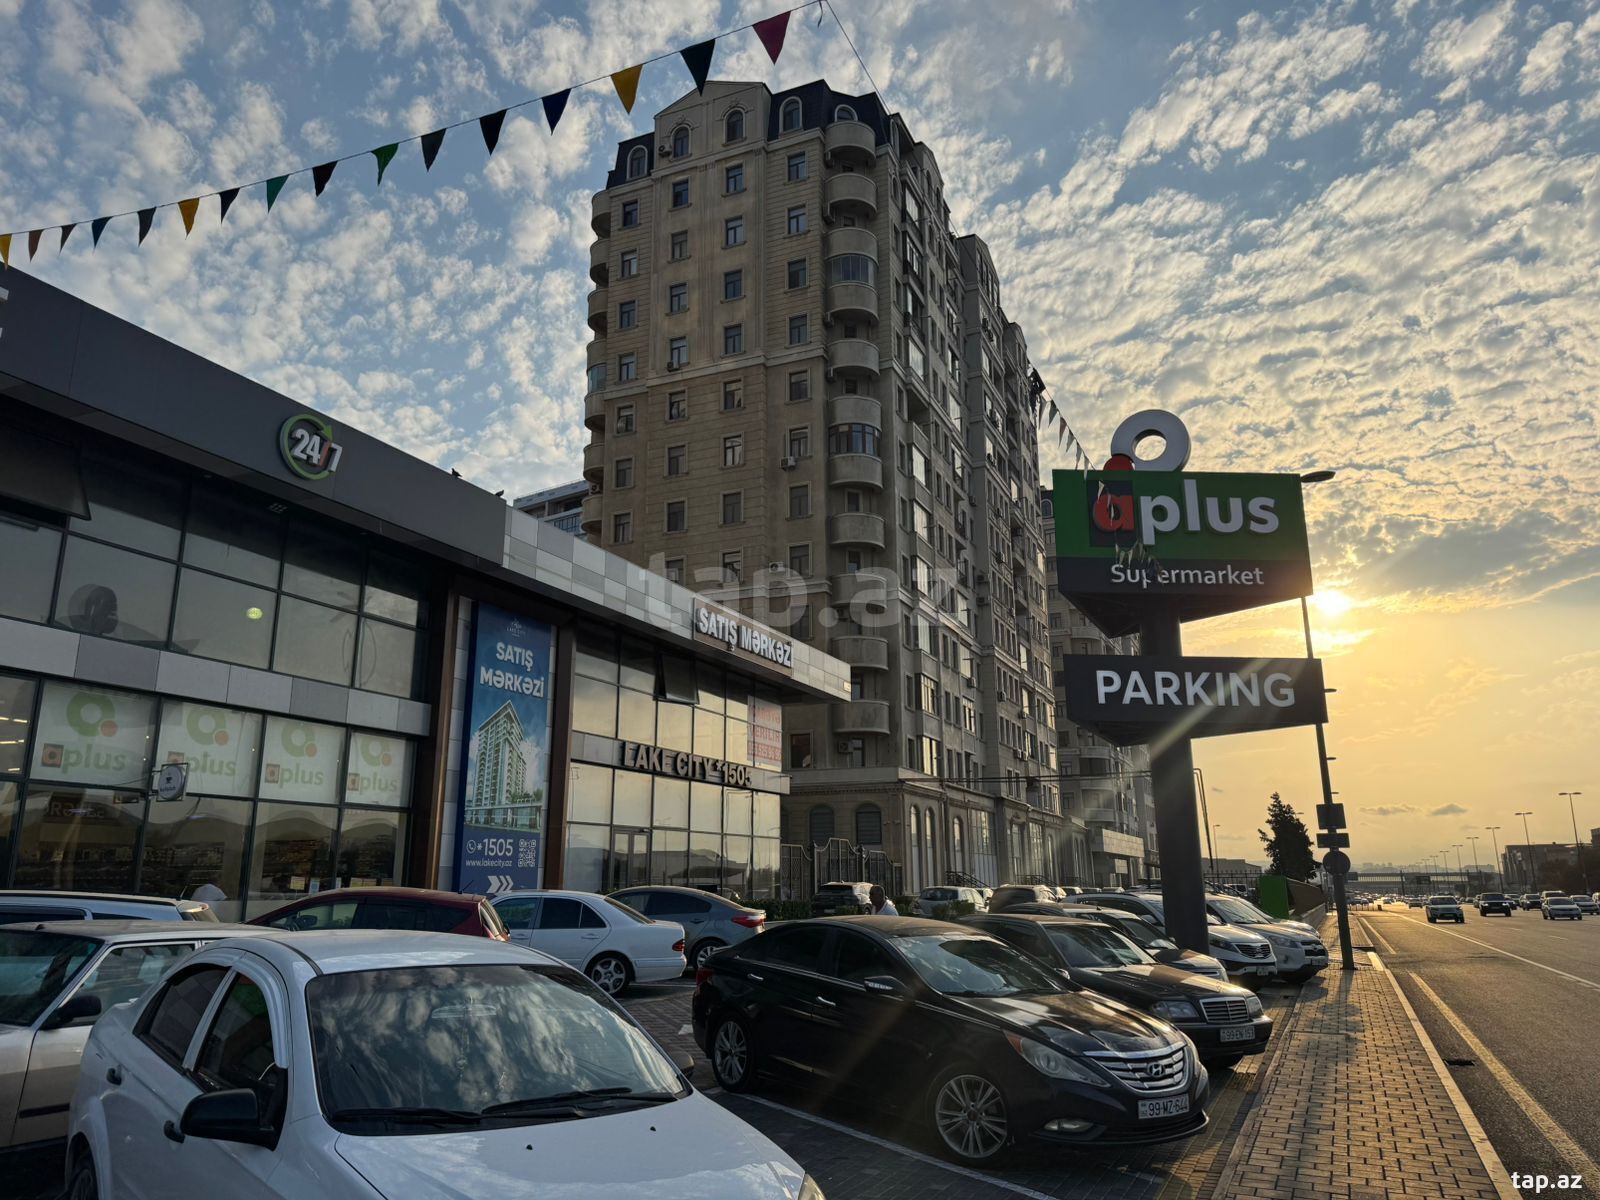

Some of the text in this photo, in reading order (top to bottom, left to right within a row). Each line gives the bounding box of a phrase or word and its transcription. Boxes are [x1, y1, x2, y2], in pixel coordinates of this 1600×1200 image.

[291, 428, 343, 472] 24/7
[1092, 479, 1280, 546] aplus
[699, 607, 738, 652] SATIŞ
[496, 641, 534, 671] SATIŞ
[480, 666, 544, 698] MƏRKƏZİ
[1096, 670, 1296, 708] PARKING
[42, 744, 127, 774] aplus
[624, 742, 673, 773] LAKE
[676, 752, 713, 780] CITY
[265, 763, 324, 788] aplus
[348, 772, 398, 794] aplus
[465, 858, 513, 868] www.lakecity.az
